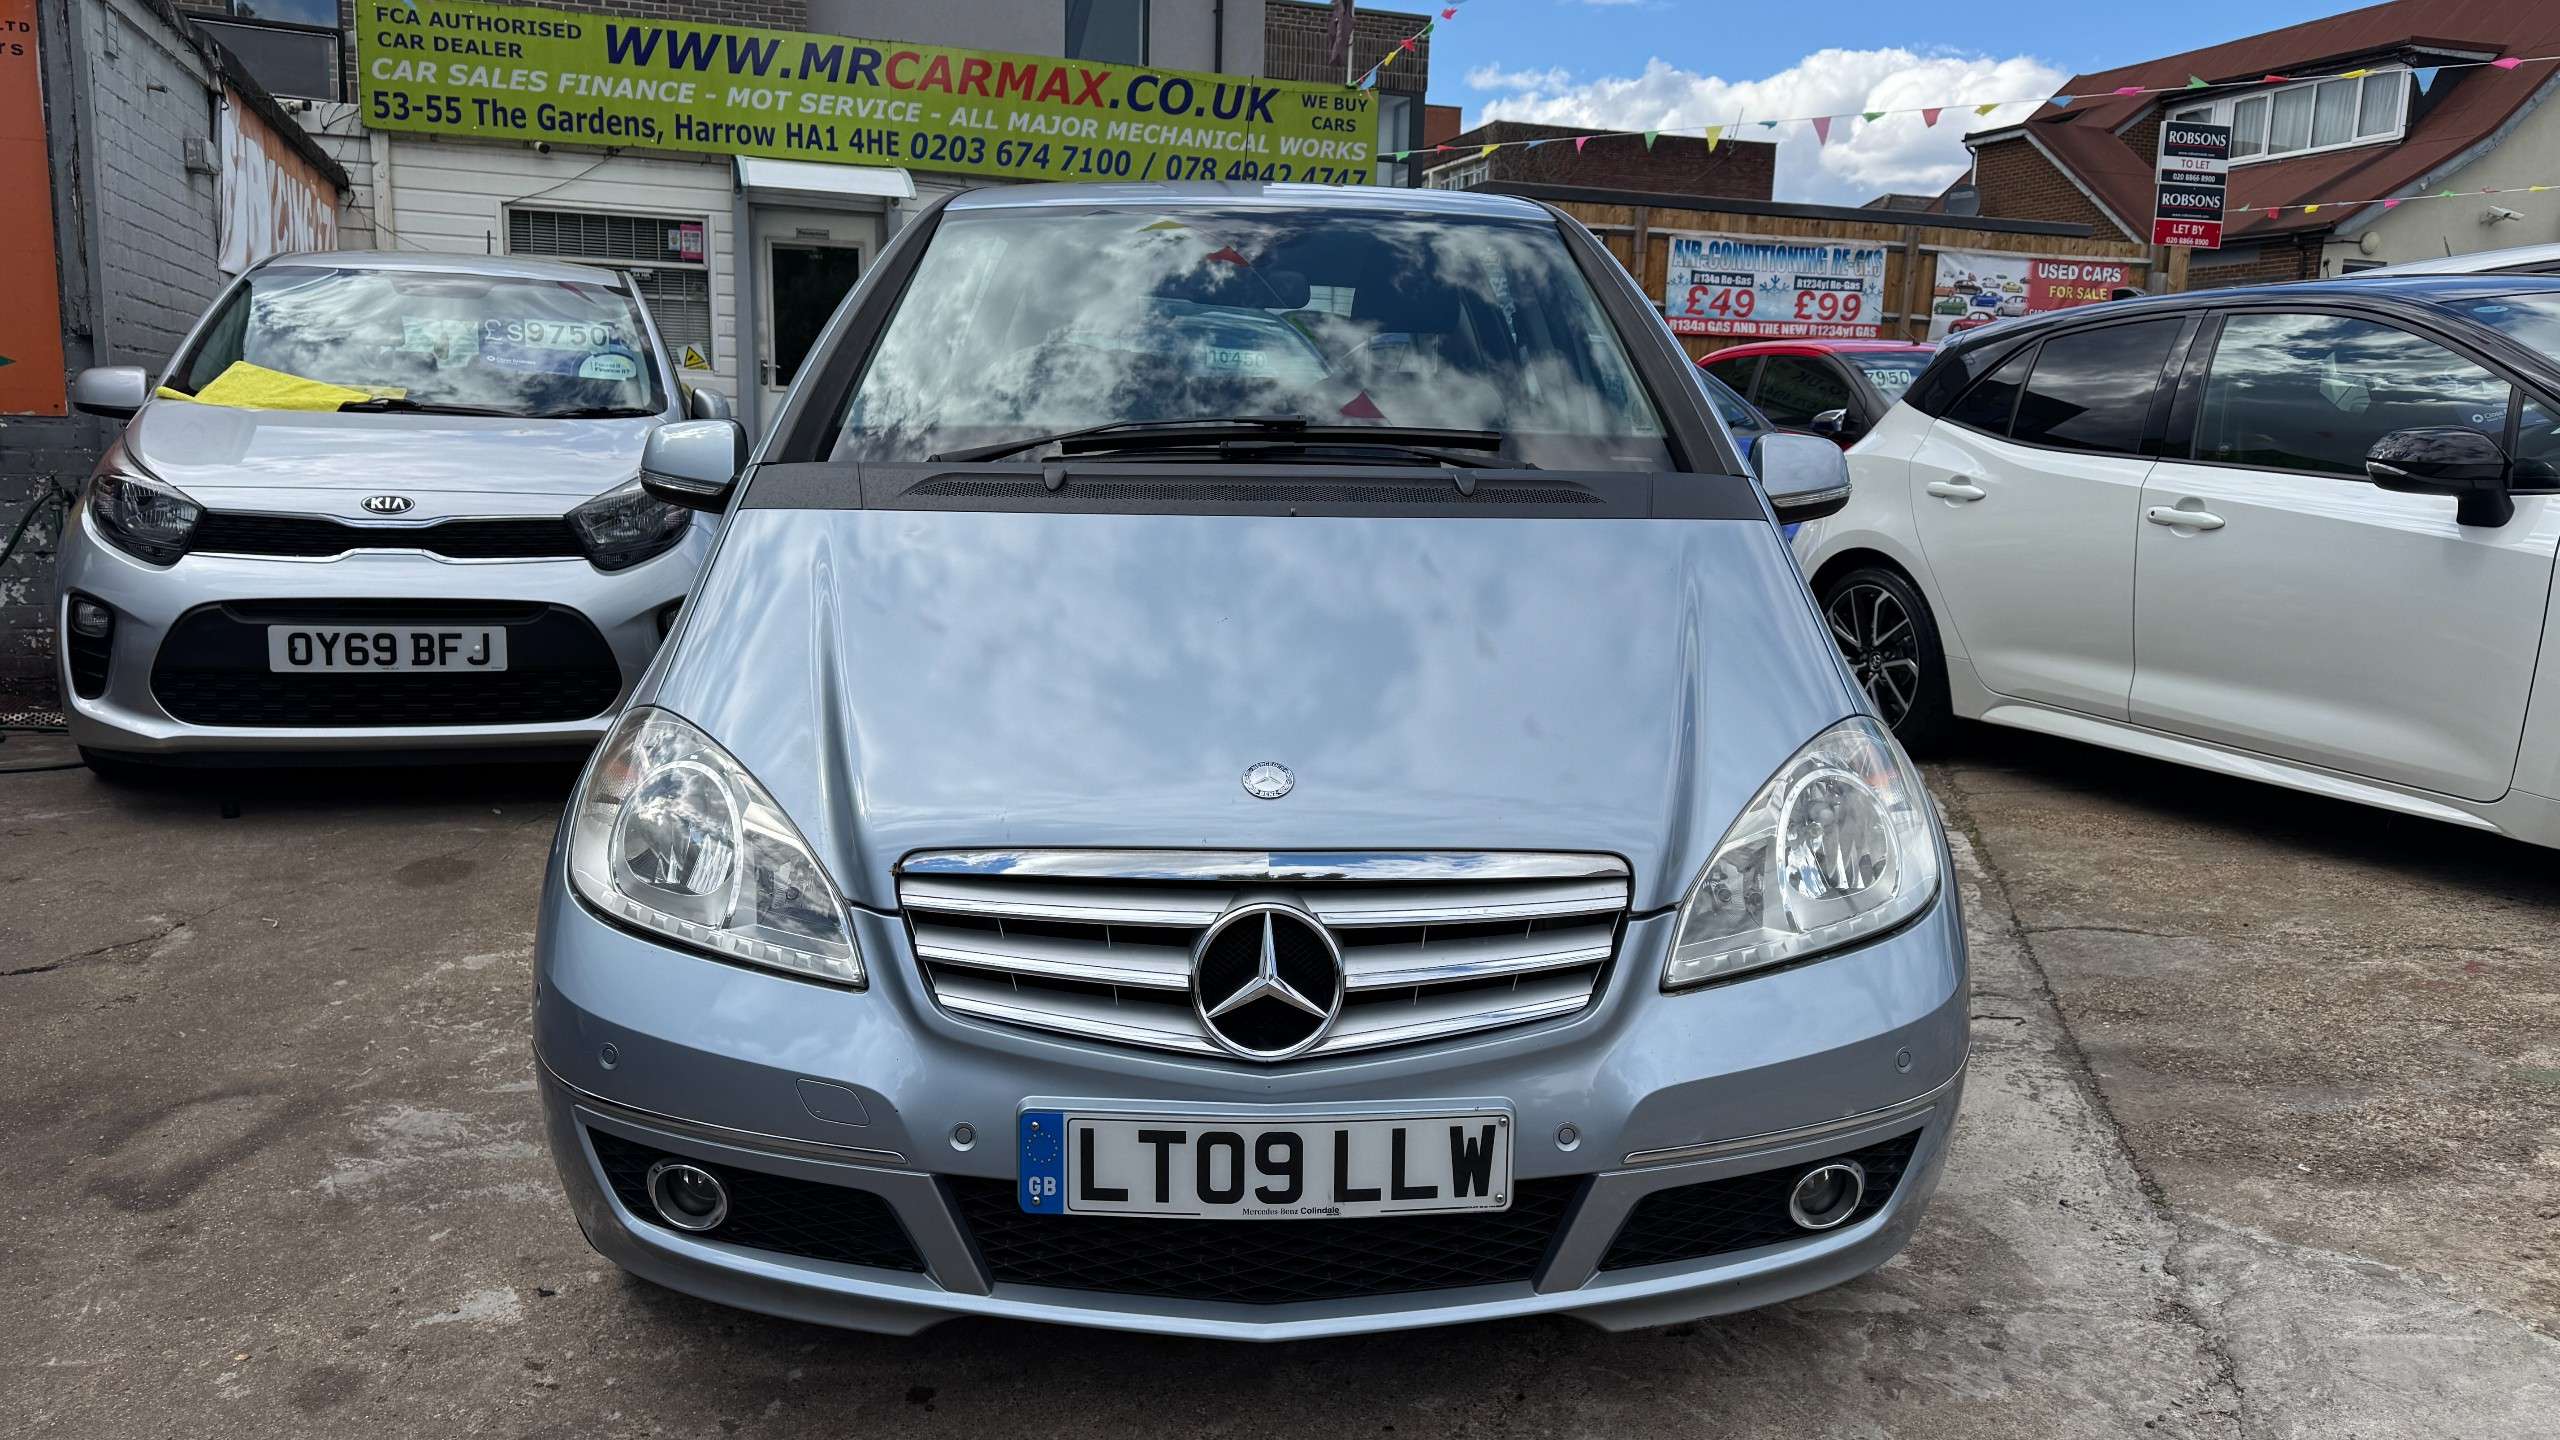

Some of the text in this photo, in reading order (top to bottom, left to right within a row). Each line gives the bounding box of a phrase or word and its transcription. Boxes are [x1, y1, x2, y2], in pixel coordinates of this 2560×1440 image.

[376, 7, 582, 40] FCA AUTHORISED
[377, 31, 523, 58] CAR DEALER
[605, 24, 1280, 124] WWW.MRCARMAX.CO.UK
[371, 58, 437, 84] CAR
[448, 63, 548, 92] SALES
[558, 73, 696, 104] FINANCE
[726, 86, 792, 111] MOT
[799, 92, 923, 123] SERVICE
[949, 107, 998, 130] ALL
[1007, 112, 1098, 138] MAJOR
[1106, 121, 1269, 153] MECHANICAL
[1279, 136, 1367, 161] WORKS
[1302, 94, 1368, 113] WE BUY
[1311, 116, 1356, 132] CARS
[372, 90, 462, 124] 53-55
[472, 98, 527, 129] The
[537, 103, 664, 145] Gardens,
[675, 113, 775, 147] Harrow
[786, 122, 838, 152] HA1
[849, 127, 900, 157] 4HE
[911, 132, 985, 164] 0203
[996, 140, 1050, 170] 674
[1061, 145, 1131, 176] 7100
[1167, 154, 1217, 181] 078
[1225, 160, 1292, 182] 4942
[2168, 131, 2227, 147] ROBSONS
[2181, 159, 2211, 170] TO LET
[2161, 193, 2221, 209] ROBSONS
[2172, 223, 2205, 235] LET BY
[1672, 239, 1883, 276] AIR-CONDITIONING RE-GAS
[1693, 273, 1752, 286] R134a Re-Gas
[2038, 262, 2121, 283] USED CARS
[1796, 278, 1861, 290] R1234yf Re-Gas
[2049, 285, 2108, 301] FOR SALE
[1685, 285, 1755, 319] £49
[1794, 290, 1862, 322] £99
[1669, 319, 1876, 337] R134a GAS AND THE NEW R1234yf GAS
[370, 497, 405, 509] KIA
[287, 632, 490, 666] OY69 BFJ
[1079, 1125, 1496, 1204] LT09 LLW
[1028, 1176, 1057, 1196] GB
[1300, 1207, 1341, 1216] Colindale
